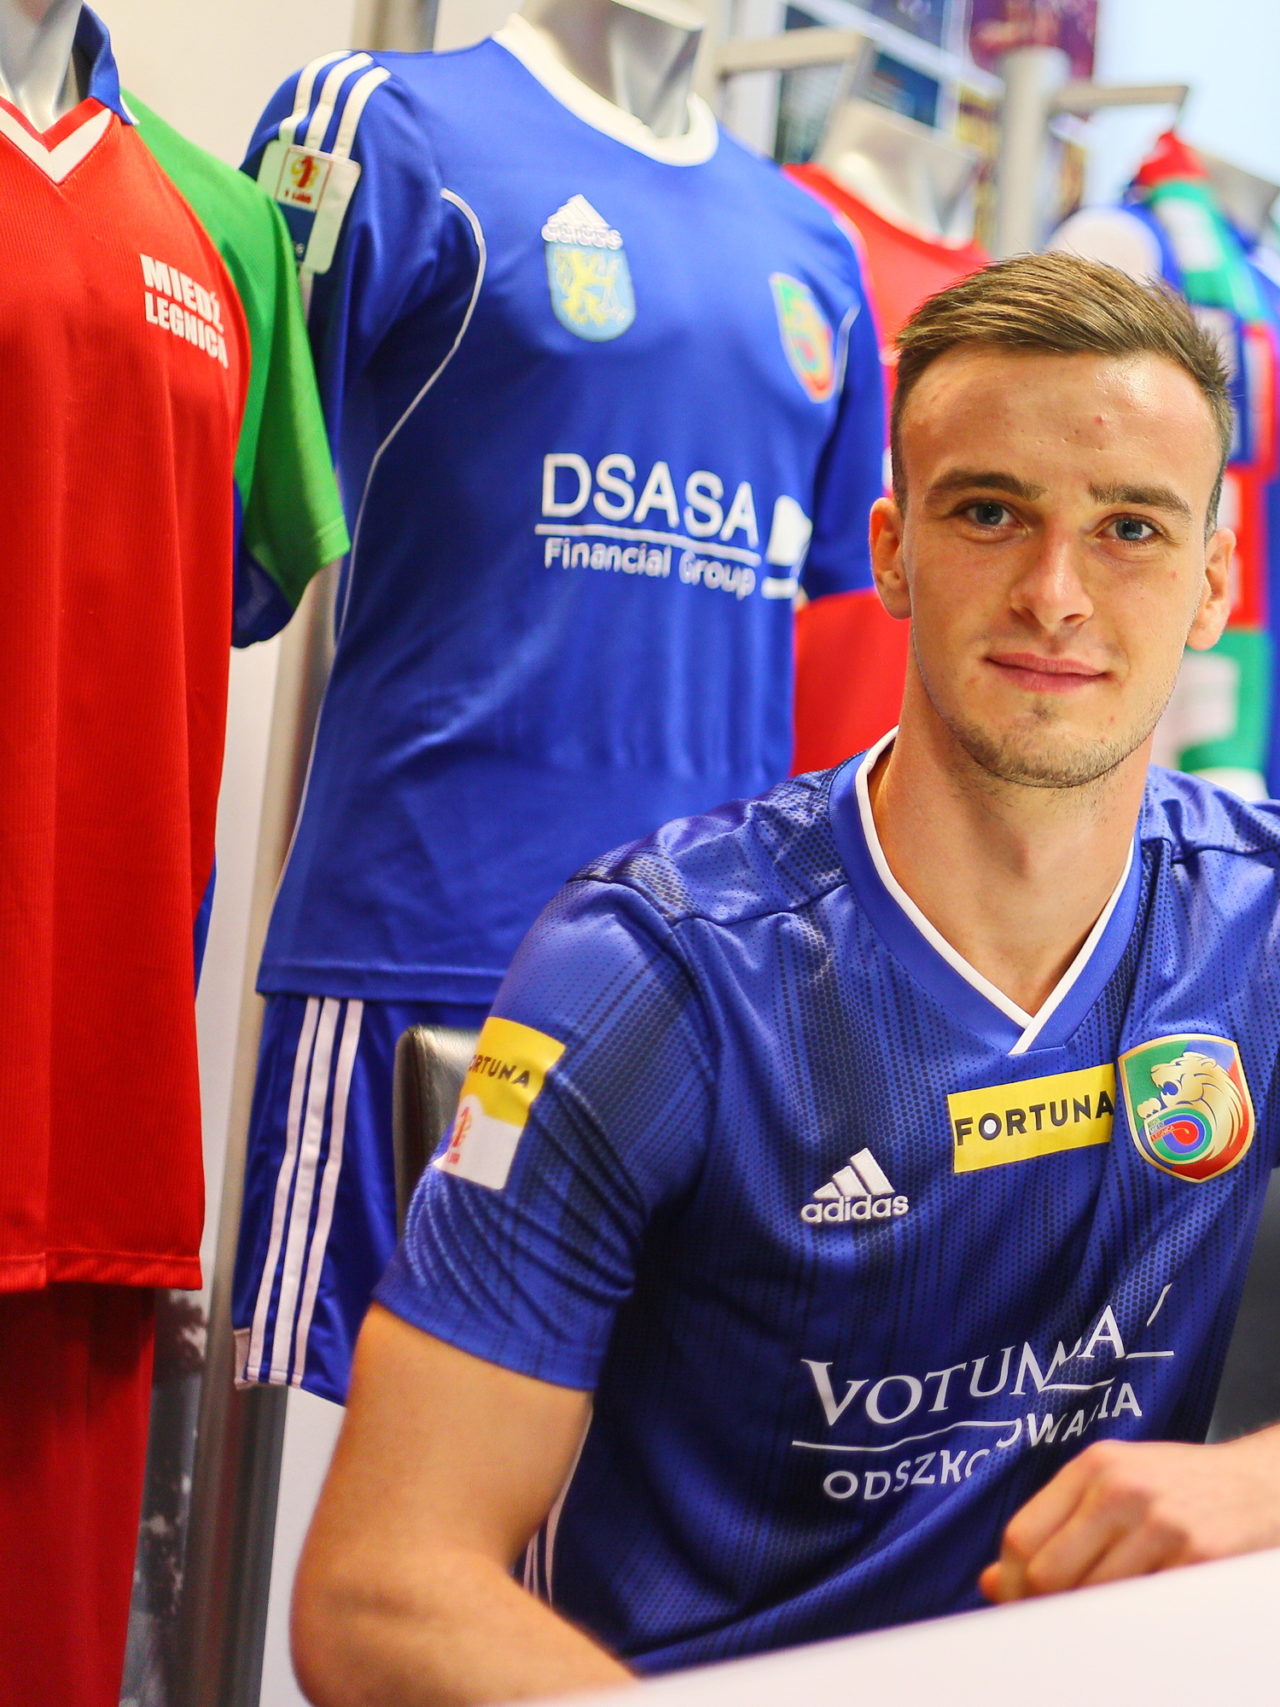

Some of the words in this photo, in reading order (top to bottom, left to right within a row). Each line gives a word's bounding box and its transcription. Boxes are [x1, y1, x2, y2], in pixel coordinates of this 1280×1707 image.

[144, 291, 229, 369] LEGNICA
[541, 453, 760, 548] DSASA
[544, 537, 672, 579] Financial
[678, 549, 756, 601] Group
[955, 1090, 1114, 1146] FORTUNA
[800, 1192, 909, 1223] adidas
